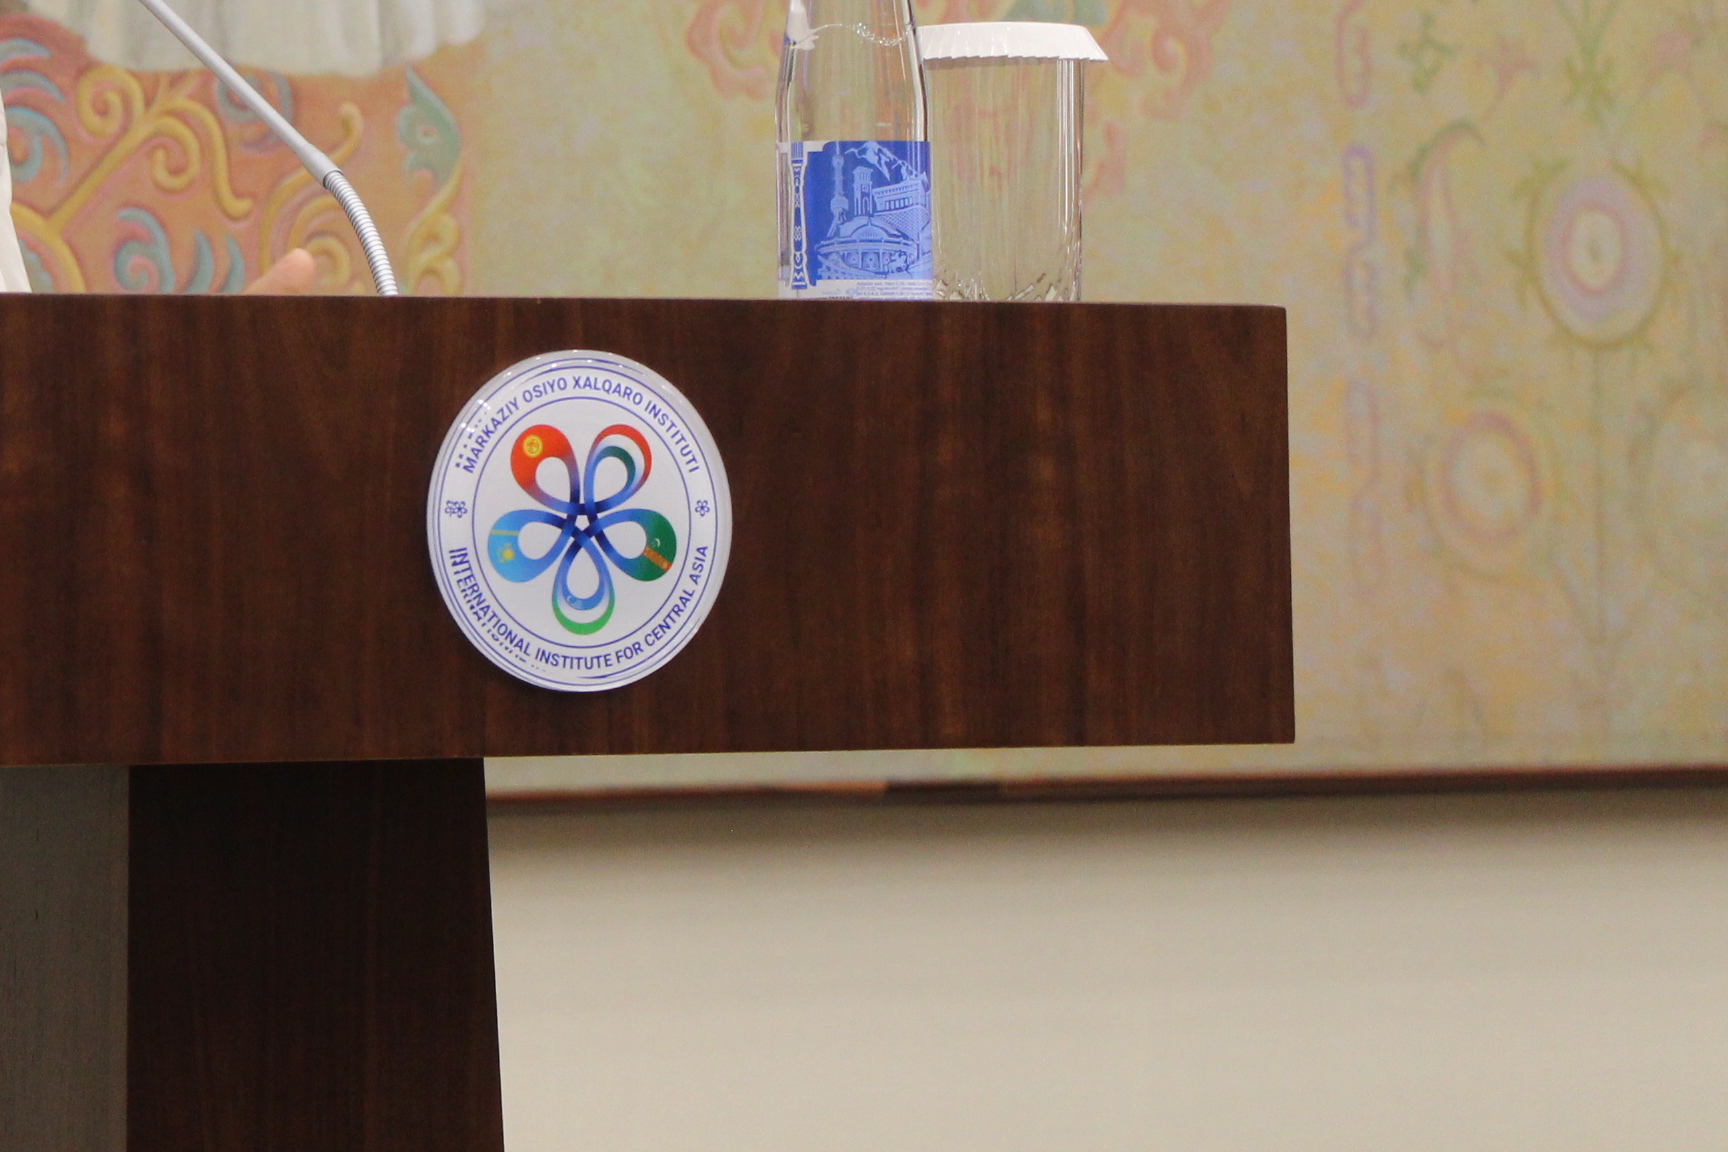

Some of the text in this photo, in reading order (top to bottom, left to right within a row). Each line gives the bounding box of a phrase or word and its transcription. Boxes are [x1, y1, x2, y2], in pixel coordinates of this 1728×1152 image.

[462, 376, 700, 474] MARKAZIY OSIYO XALQARO INSTITUTI
[450, 545, 708, 670] INTERNATIONAL INSTITUTE FOR CENTRAL ASIA
